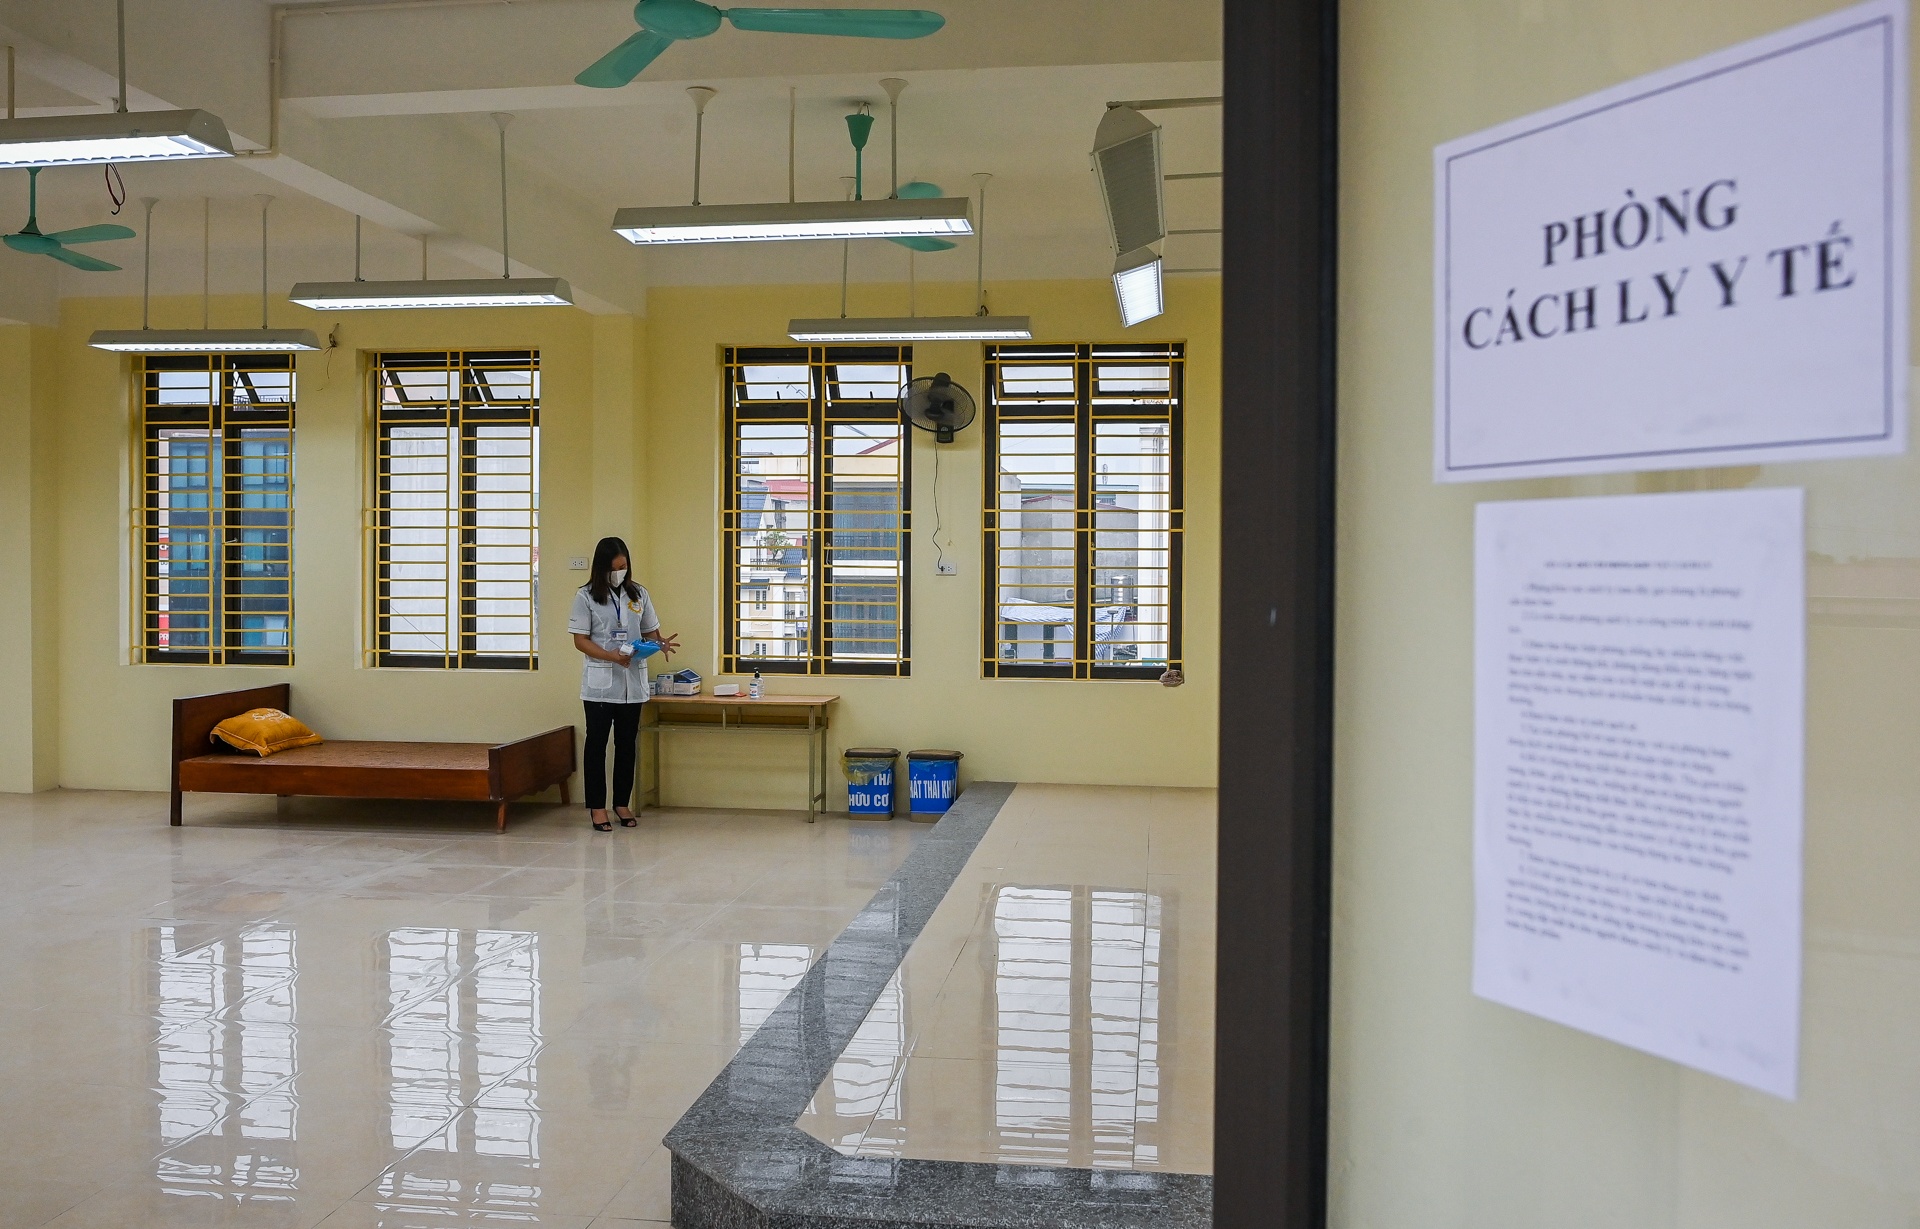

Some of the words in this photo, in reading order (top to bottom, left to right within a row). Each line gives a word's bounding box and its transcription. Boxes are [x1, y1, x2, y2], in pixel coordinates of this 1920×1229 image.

[1543, 179, 1739, 268] PHÒNG
[1463, 285, 1597, 350] CÁCH
[1616, 266, 1690, 326] LY
[1709, 254, 1749, 309] Y
[873, 793, 890, 807] CƠ
[923, 773, 941, 799] THẢI
